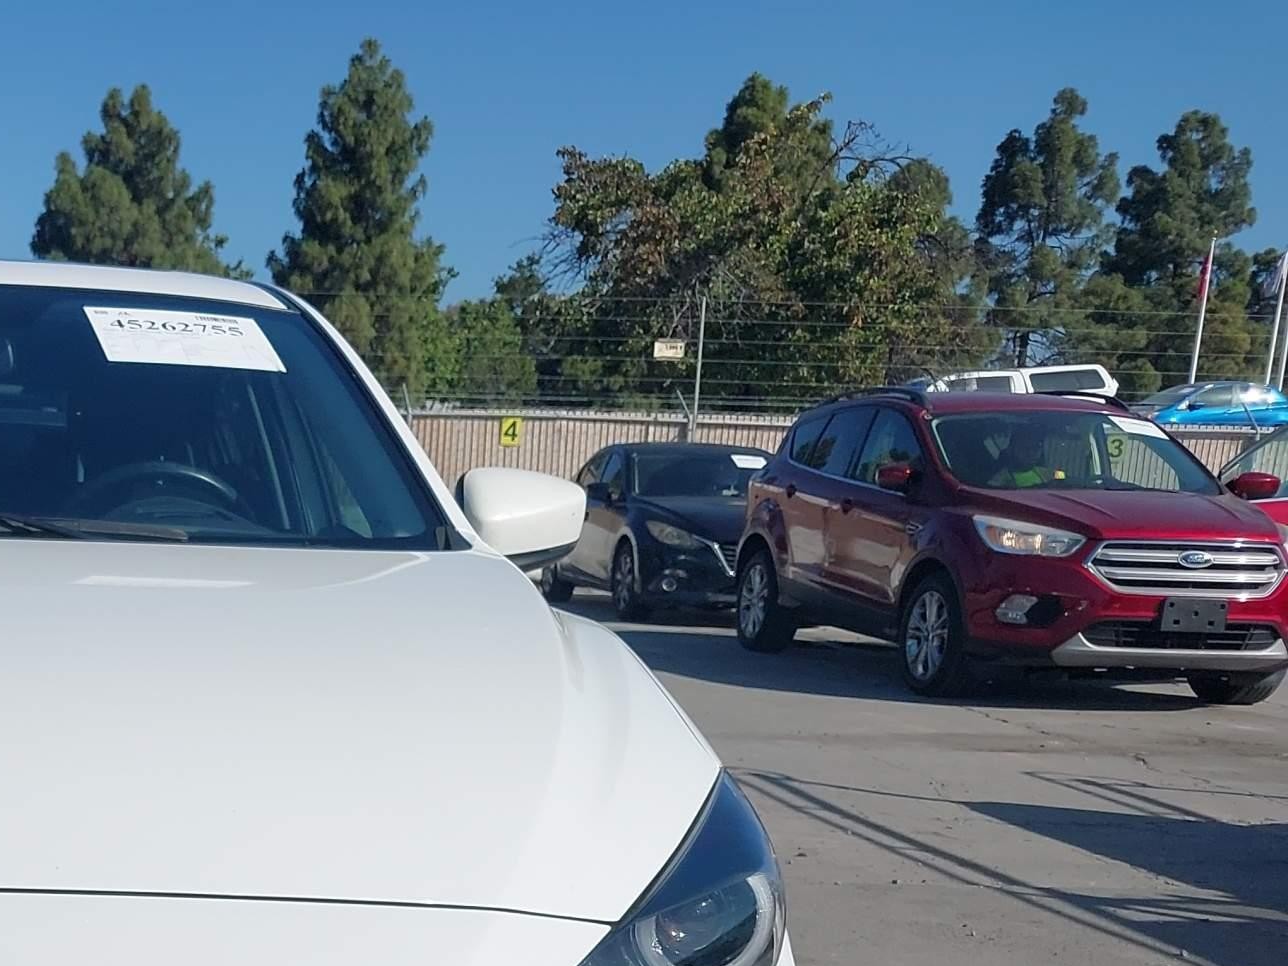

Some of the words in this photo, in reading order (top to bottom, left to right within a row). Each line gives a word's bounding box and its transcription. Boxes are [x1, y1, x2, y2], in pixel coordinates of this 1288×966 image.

[110, 319, 244, 337] 45262755
[504, 420, 518, 442] 4
[1109, 439, 1124, 458] 3
